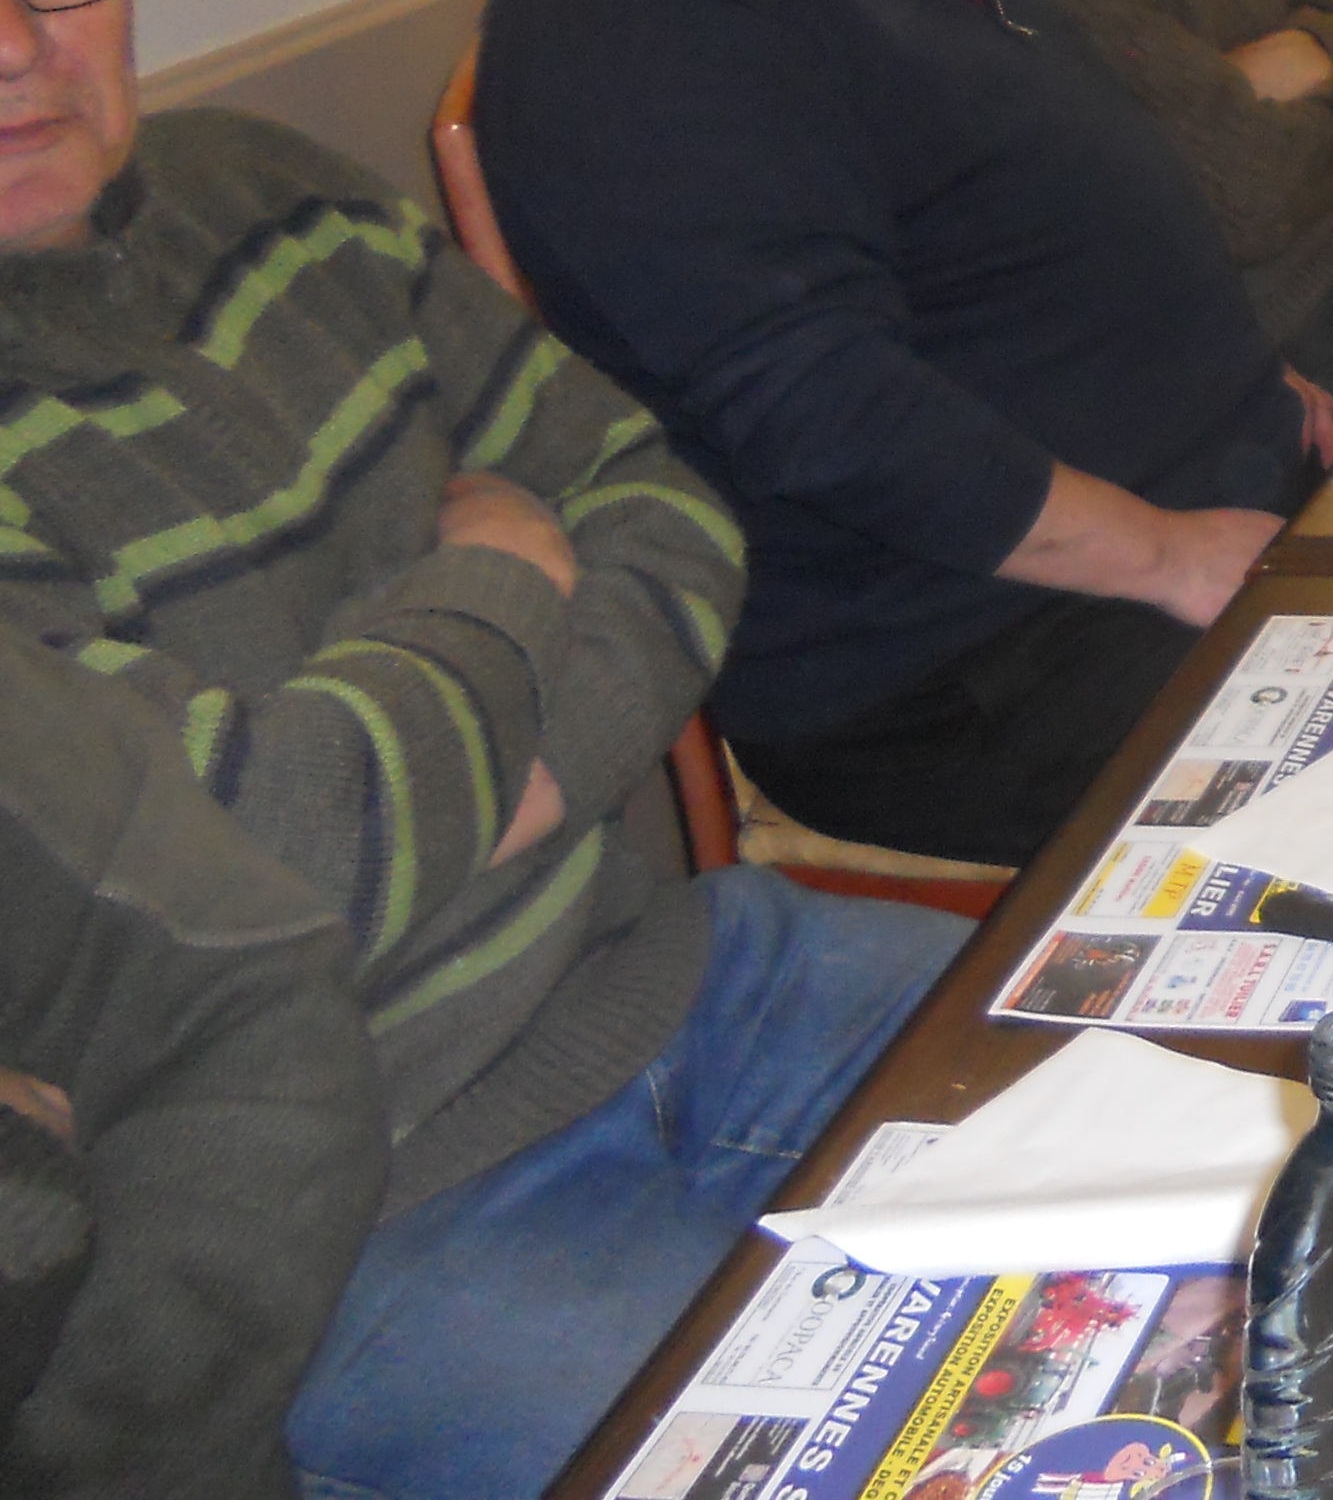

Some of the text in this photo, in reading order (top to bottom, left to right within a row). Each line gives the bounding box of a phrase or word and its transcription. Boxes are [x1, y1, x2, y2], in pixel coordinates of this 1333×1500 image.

[947, 1285, 1004, 1367] EXPOSITION
[960, 1295, 1016, 1378] EXPOSITION
[891, 1366, 954, 1459] AUTOMOBILE
[905, 1377, 966, 1467] ARTISANALE
[892, 1466, 910, 1488] ET
